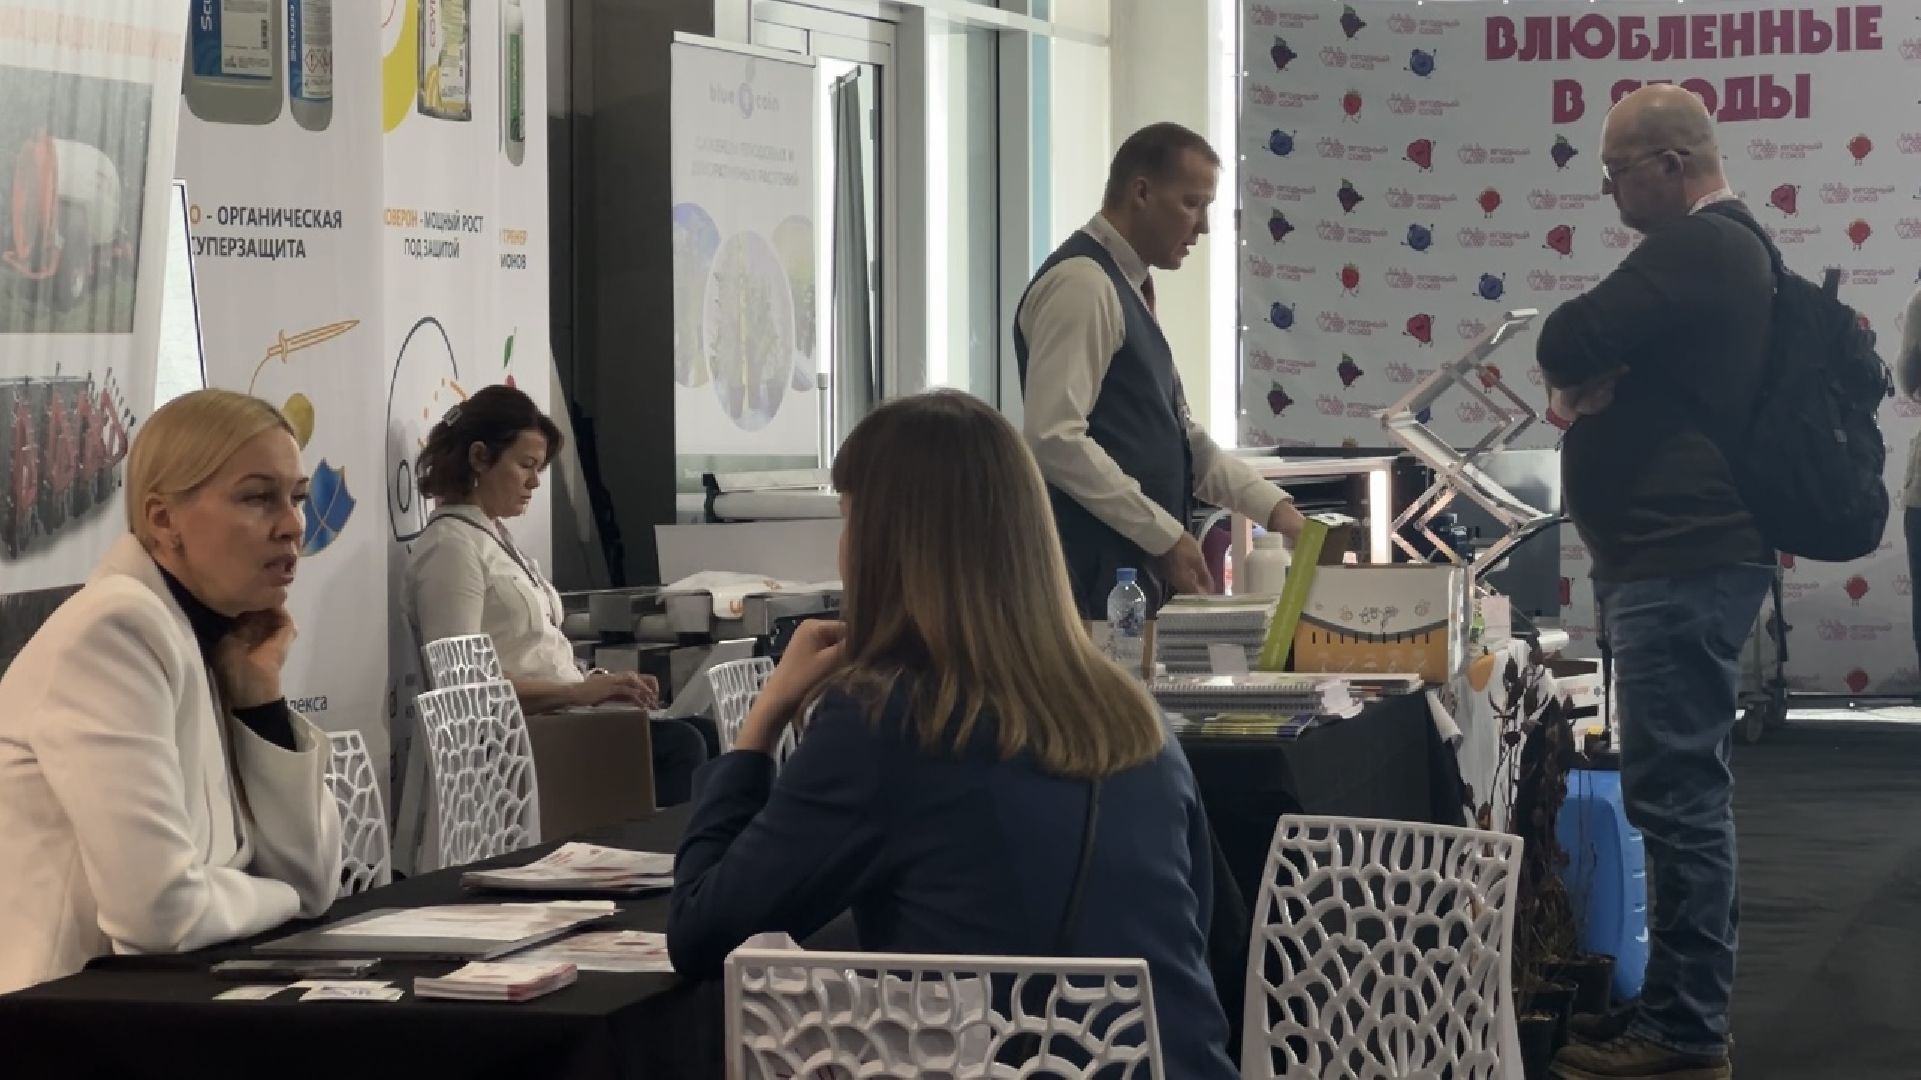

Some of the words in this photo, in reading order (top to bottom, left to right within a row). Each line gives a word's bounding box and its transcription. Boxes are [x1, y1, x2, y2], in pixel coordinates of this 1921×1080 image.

[1485, 5, 1883, 62] ВЛЮБЛЕННЫЕ
[1552, 79, 1586, 124] В
[1611, 74, 1811, 123] ОДЫ
[217, 205, 342, 229] ОРГАНИЧЕСКАЯ
[424, 209, 460, 233] МОЩНЫЙ
[462, 214, 484, 233] РОСТ
[404, 238, 423, 261] ПОД
[423, 237, 460, 261] ЗАЩИТОЙ
